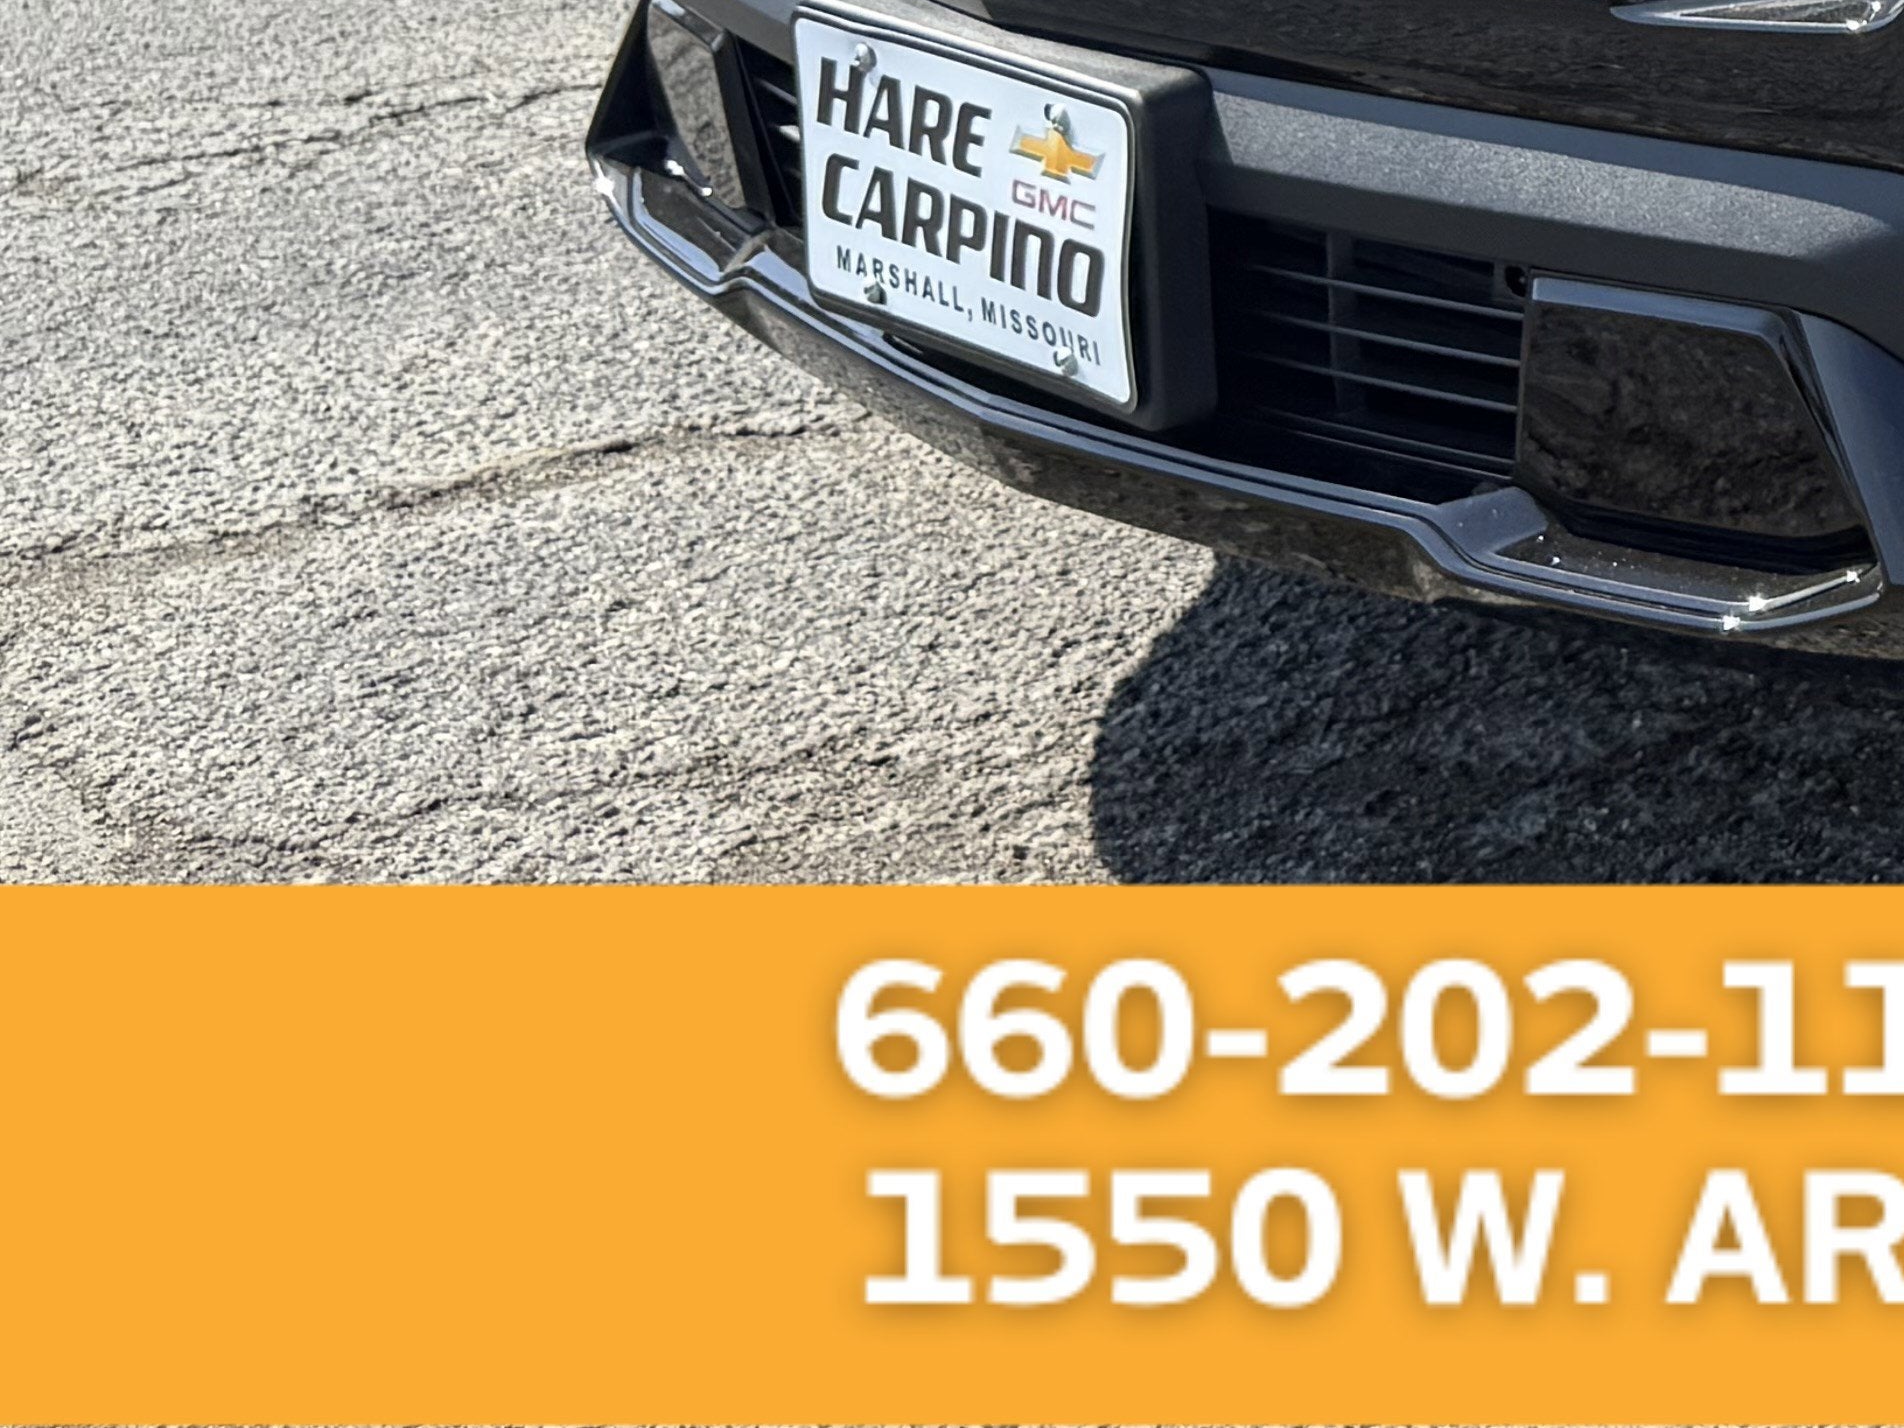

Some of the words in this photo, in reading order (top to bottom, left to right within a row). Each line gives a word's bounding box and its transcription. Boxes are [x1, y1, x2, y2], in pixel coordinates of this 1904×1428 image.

[816, 56, 993, 178] HARE
[821, 152, 1106, 318] CARPINO
[1011, 178, 1097, 231] GMC
[835, 244, 974, 323] MARSHALL,
[980, 296, 1102, 366] MISSOURI
